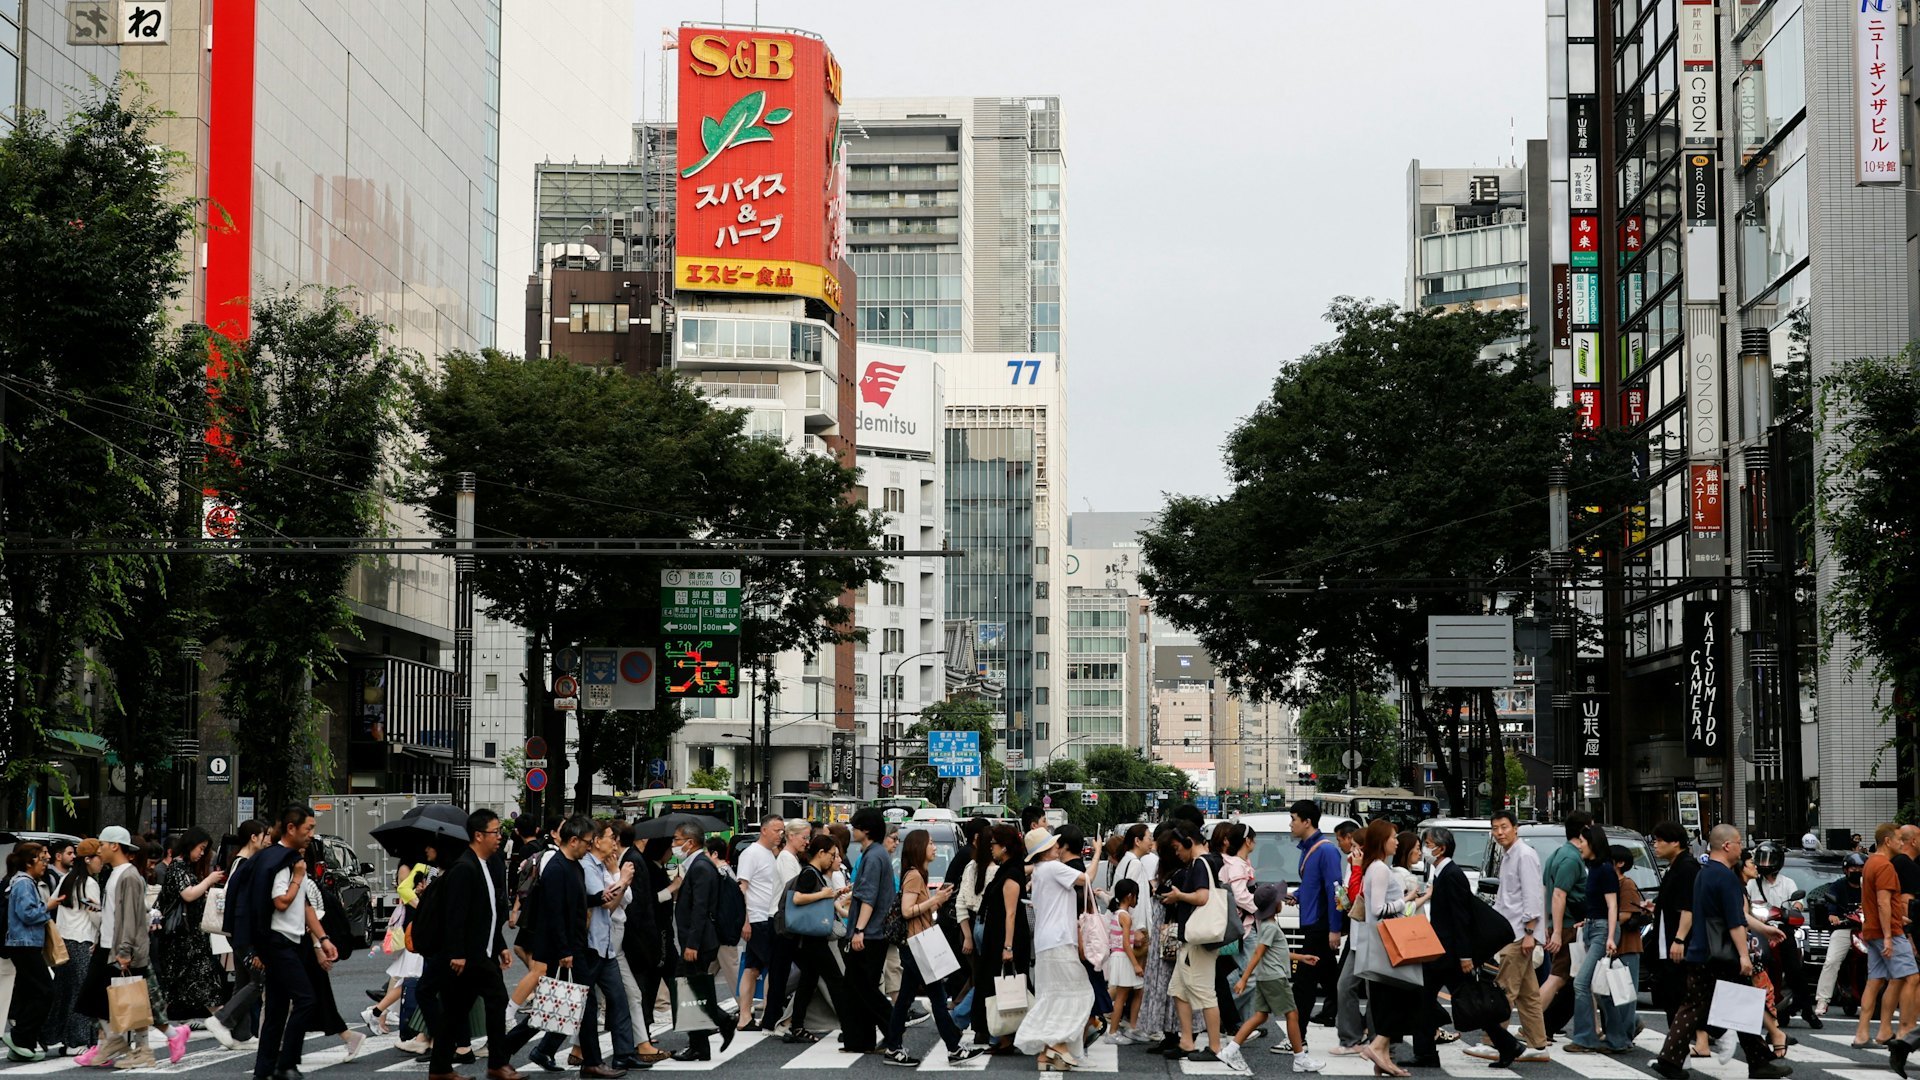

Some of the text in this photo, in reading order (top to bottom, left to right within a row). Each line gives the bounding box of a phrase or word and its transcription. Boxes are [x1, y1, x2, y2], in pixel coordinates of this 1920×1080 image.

[128, 6, 162, 38] ね
[690, 34, 794, 80] S&B
[1868, 20, 1889, 152] ニューギンザビル
[1692, 77, 1706, 132] C'BON
[1584, 165, 1592, 201] カツミ堂
[1864, 161, 1896, 172] 10号館
[695, 172, 786, 210] スパイス
[1696, 184, 1706, 218] GINZA
[714, 214, 784, 248] ハーブ
[738, 204, 757, 223] &
[687, 264, 794, 288] エスビー食品
[1590, 276, 1596, 284] Le
[1007, 360, 1041, 385] 77
[1696, 352, 1713, 443] SONOKO
[1695, 477, 1704, 522] ステーキ
[1706, 469, 1718, 504] 銀座の
[669, 574, 677, 582] C1
[723, 574, 731, 582] C1
[1704, 612, 1716, 746] KATSUMIDO
[1690, 655, 1702, 739] CAMERA
[1583, 700, 1600, 756] 山形屋
